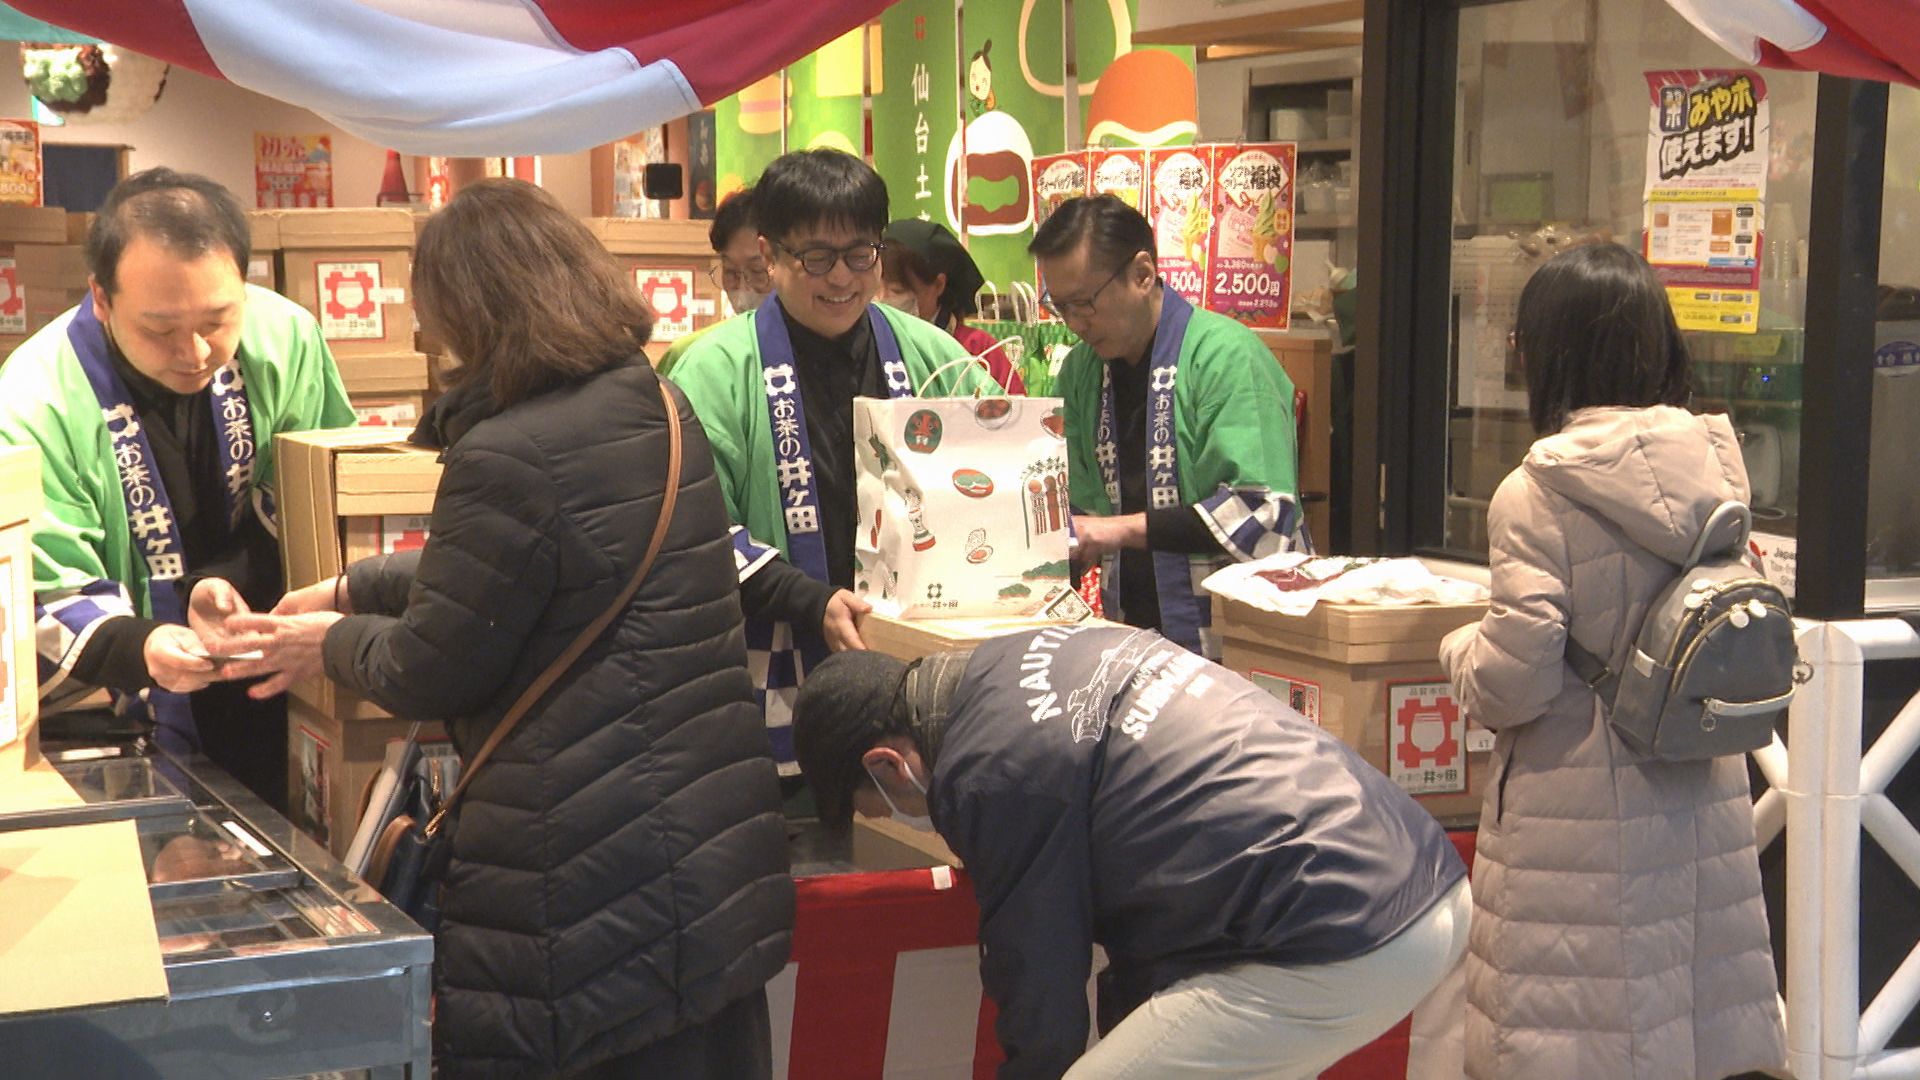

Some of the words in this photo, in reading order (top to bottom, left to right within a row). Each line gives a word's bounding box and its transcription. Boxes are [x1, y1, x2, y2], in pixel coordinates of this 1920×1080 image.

[1214, 271, 1280, 297] 2,500円
[115, 442, 185, 580] お茶の井ヶ田
[773, 398, 819, 535] お茶の井ヶ田
[1149, 393, 1180, 511] お茶の井ヶ田
